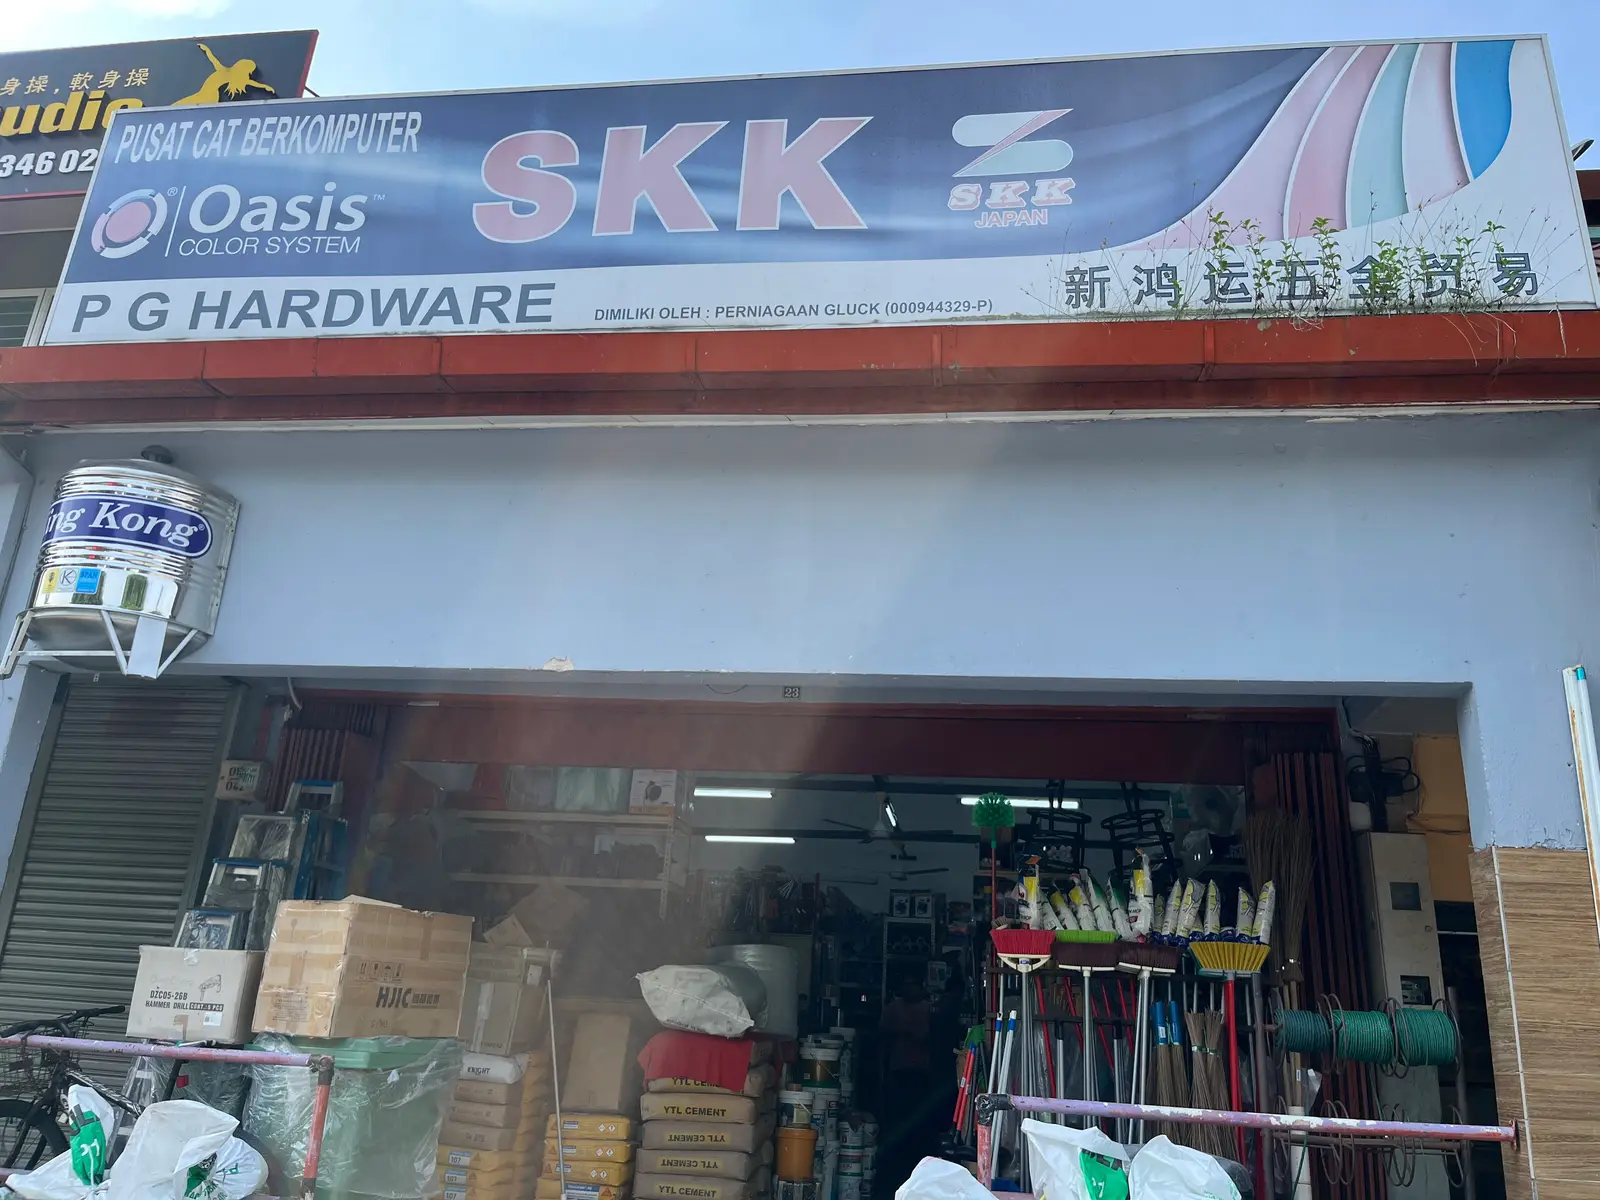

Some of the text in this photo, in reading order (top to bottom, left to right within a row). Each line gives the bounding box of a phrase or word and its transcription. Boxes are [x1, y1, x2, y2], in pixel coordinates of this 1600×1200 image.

[114, 111, 423, 164] PUSAT CAT BERKOMPUTER
[0, 151, 56, 177] 346
[472, 116, 874, 243] SKK
[947, 177, 1076, 211] SKK
[188, 181, 368, 234] Oasis
[974, 208, 1048, 228] JAPAN
[179, 235, 361, 256] COLOR SYSTEM
[71, 282, 556, 333] P G HARDWARE
[594, 307, 655, 321] DIMILIKI
[658, 306, 701, 320] OLEH
[714, 304, 819, 319] PERNIAGAAN
[824, 302, 880, 316] GLUCK
[884, 299, 993, 317] (000944329-P)
[45, 501, 198, 548] ing Kong
[784, 687, 799, 698] 23
[145, 1000, 171, 1009] HAMMER
[173, 1002, 188, 1010] DRILL
[664, 1106, 727, 1117] YTL CEMENT
[667, 1134, 705, 1142] CEMENT
[661, 1158, 718, 1169] YTL CEMENT
[659, 1185, 717, 1198] YTL CEMENT
